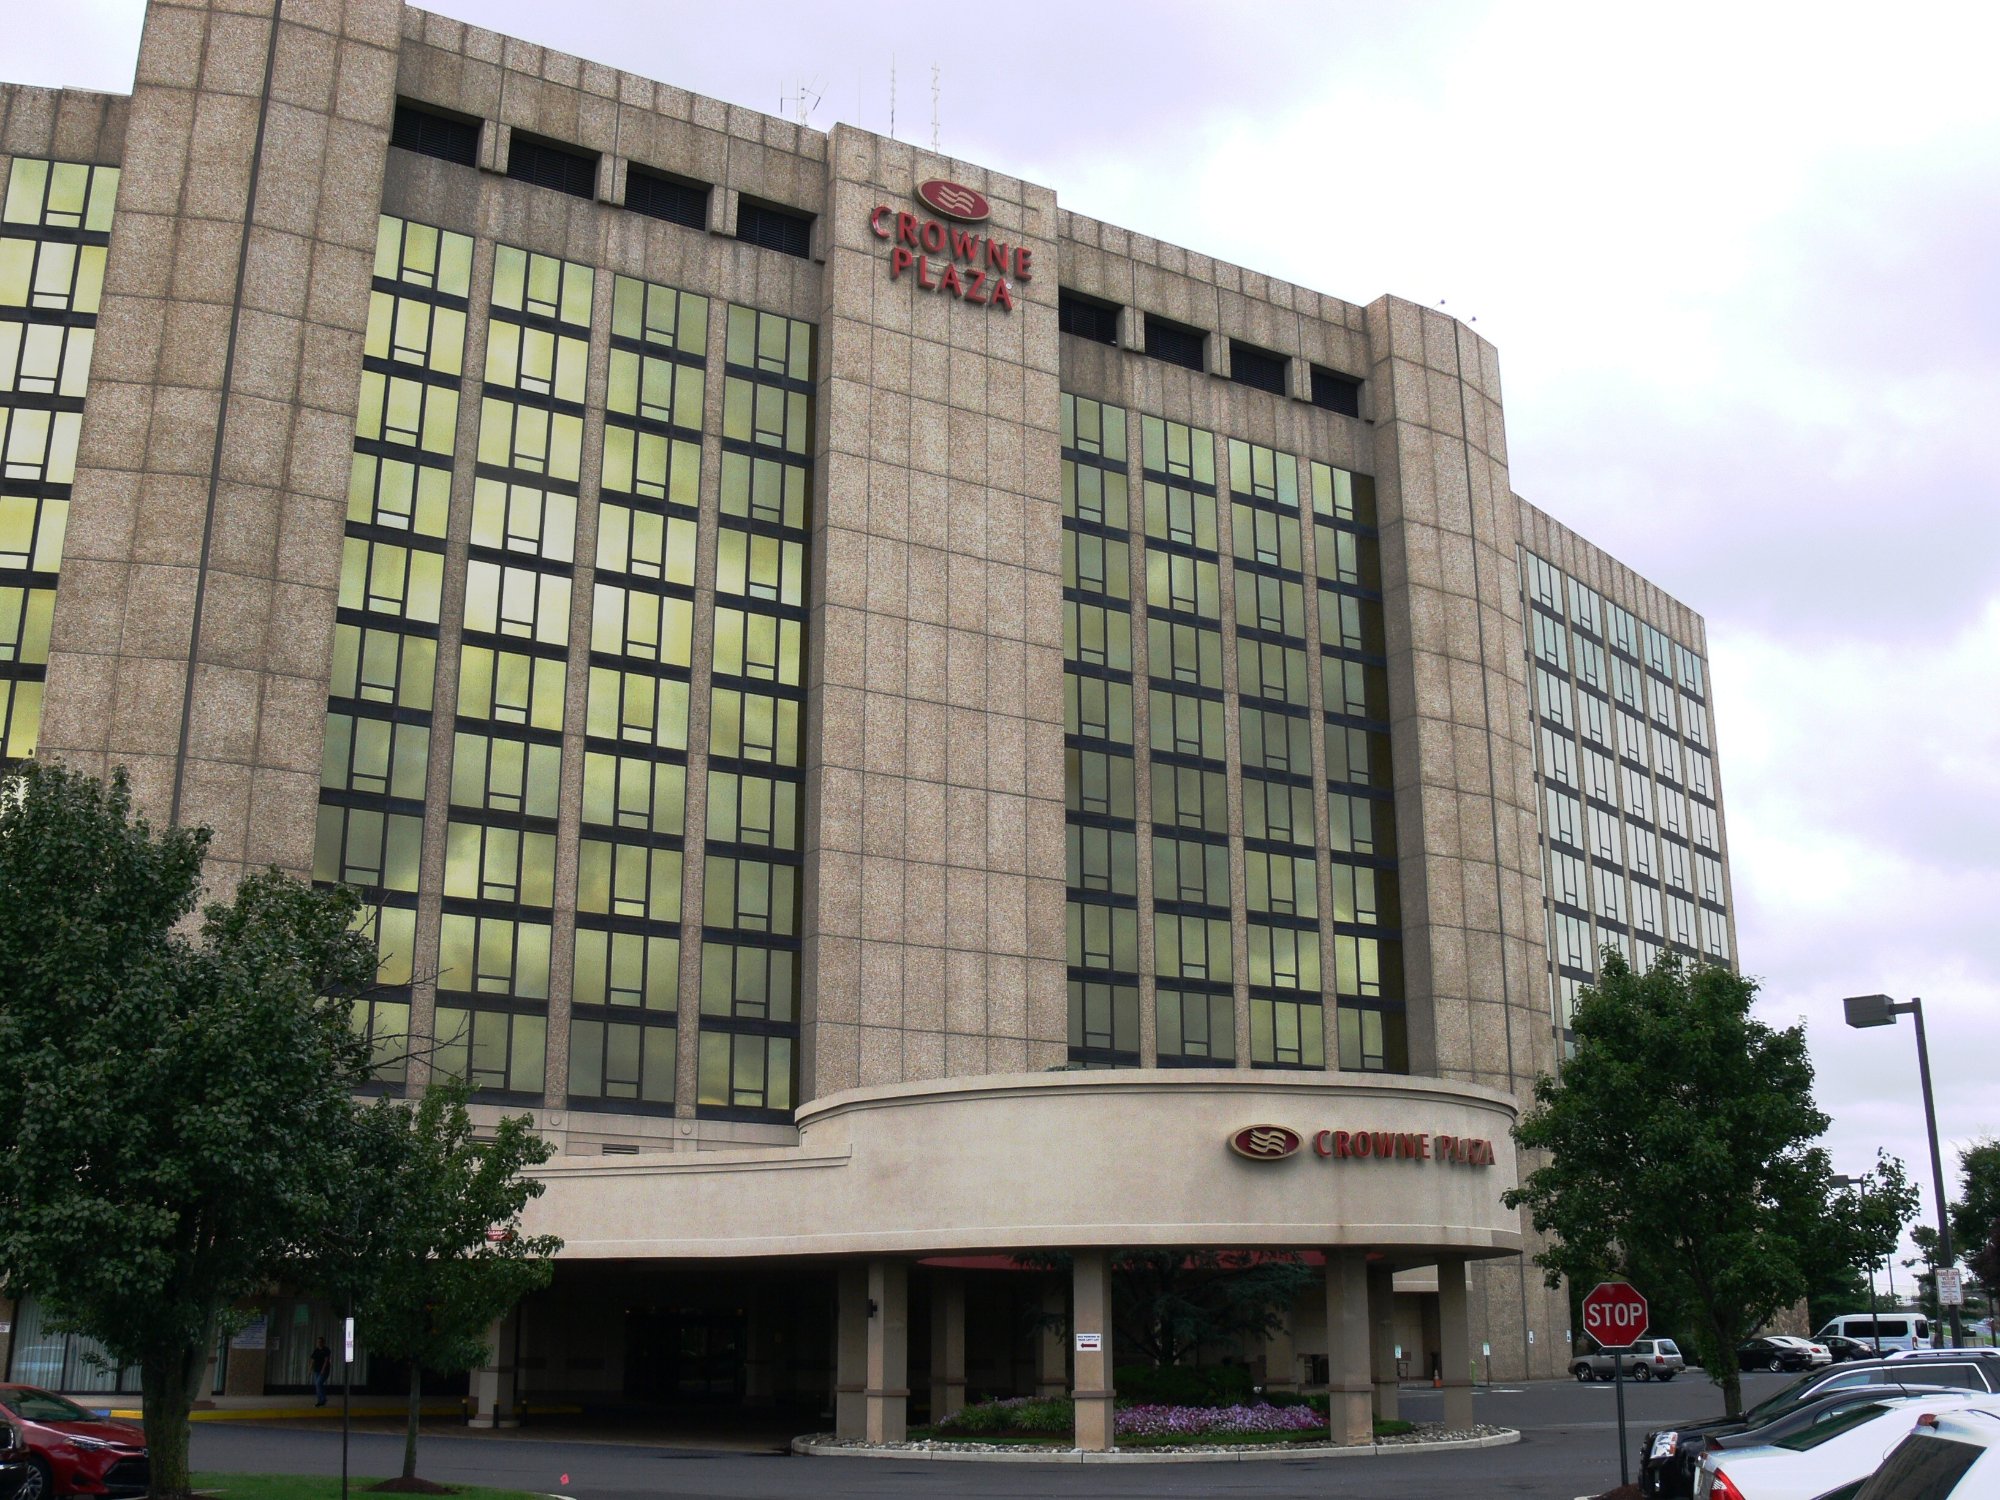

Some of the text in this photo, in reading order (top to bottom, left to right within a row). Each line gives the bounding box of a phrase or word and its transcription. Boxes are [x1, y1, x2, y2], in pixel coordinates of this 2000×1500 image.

[871, 205, 1032, 281] CROWNE
[890, 246, 1012, 311] PLAZA
[1313, 1129, 1496, 1166] CROWNE PLAZA
[1587, 1302, 1643, 1327] STOP
